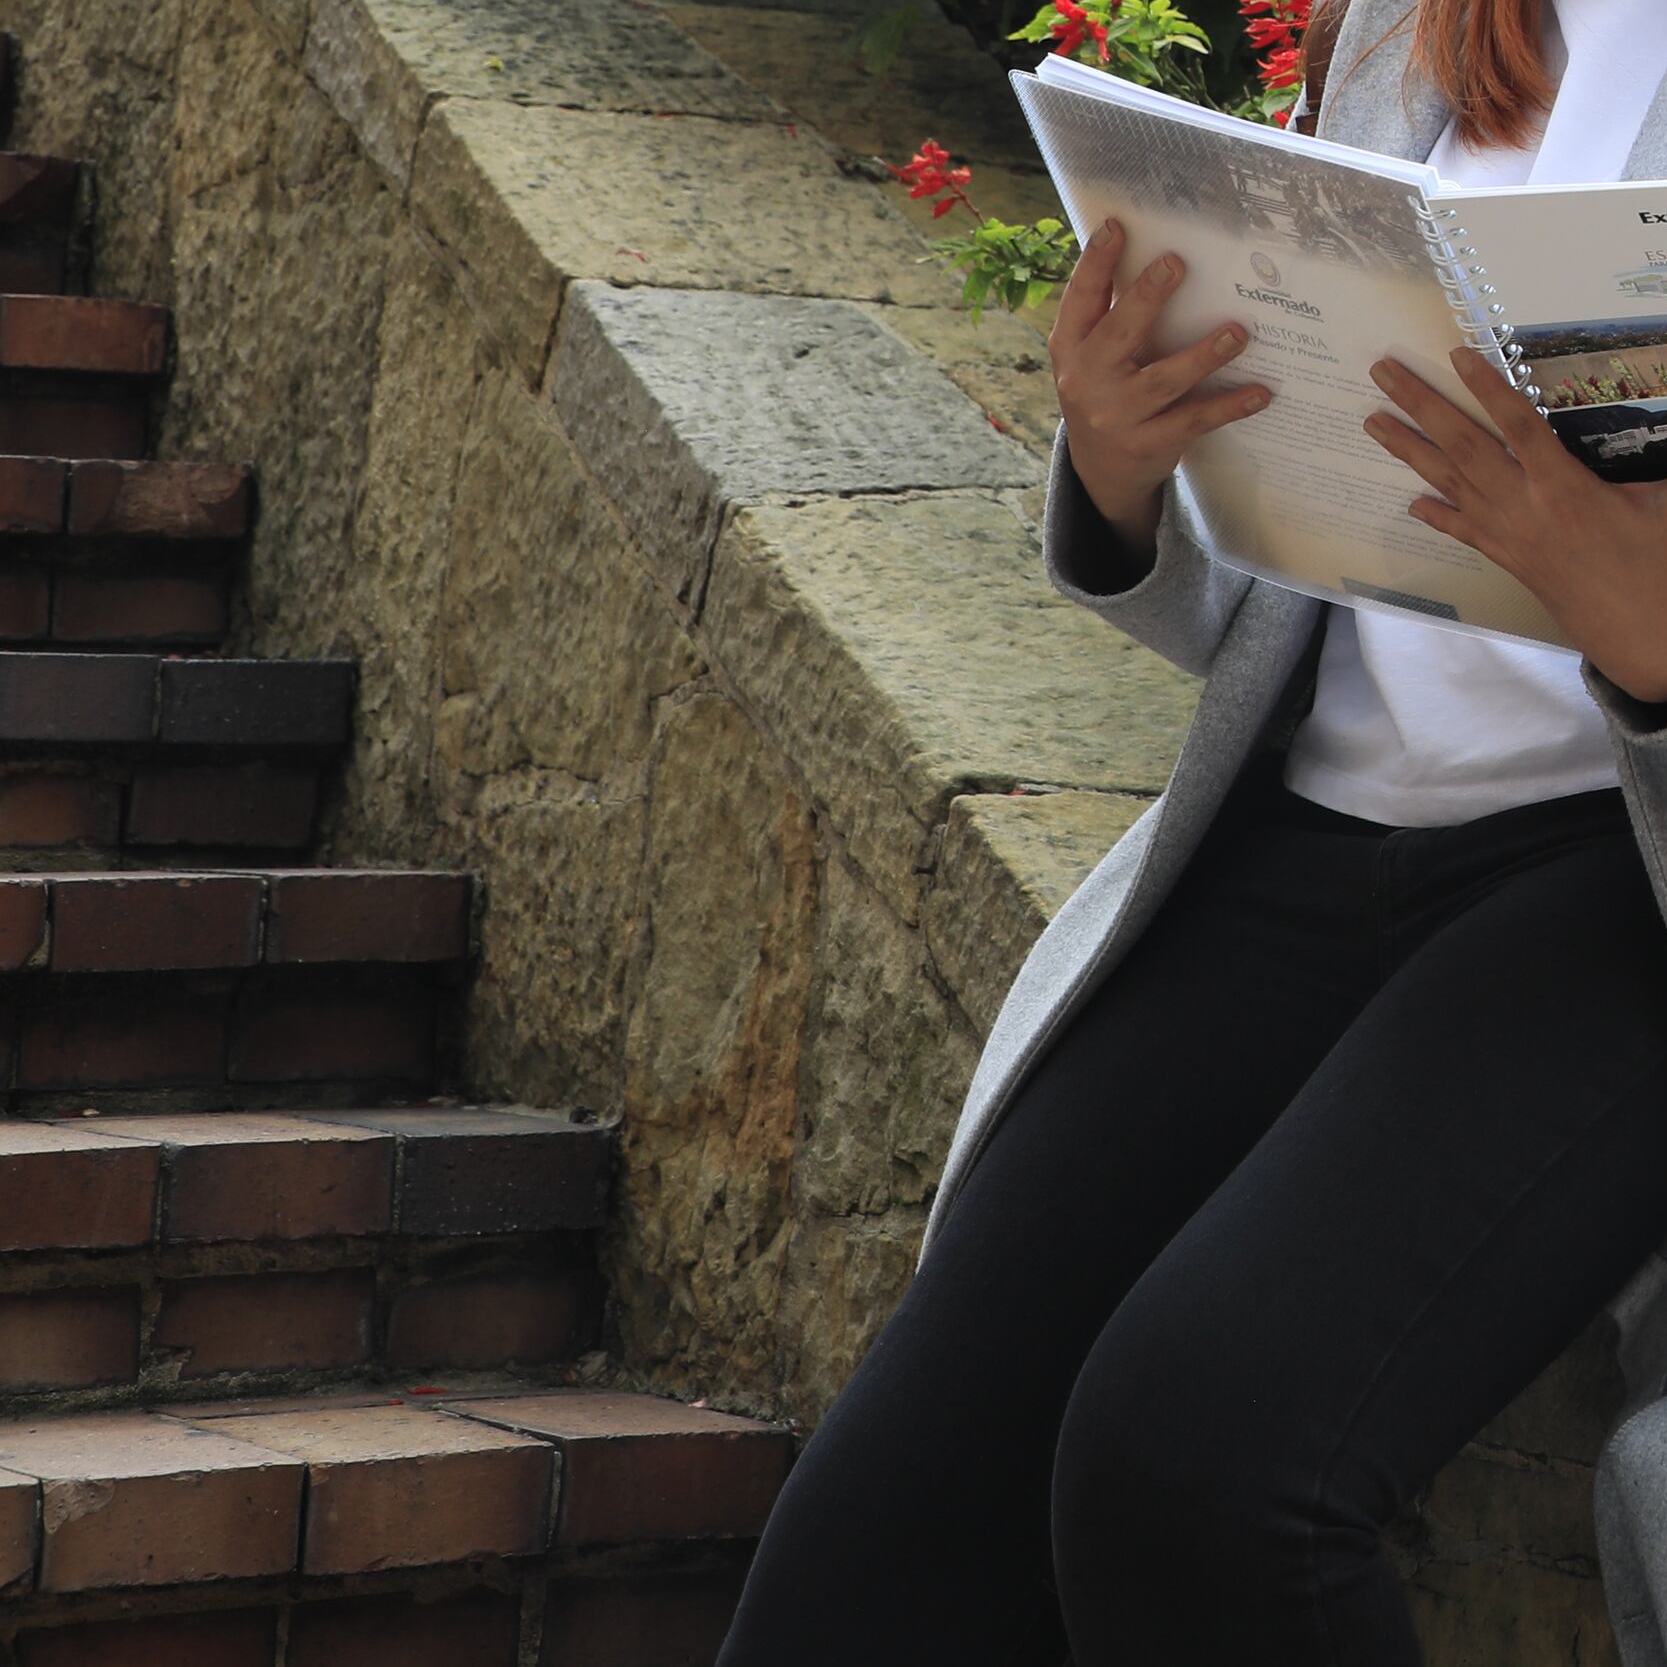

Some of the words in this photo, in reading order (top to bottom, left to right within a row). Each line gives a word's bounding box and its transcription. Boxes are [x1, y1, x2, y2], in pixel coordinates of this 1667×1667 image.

[1234, 283, 1321, 316] Externado
[1253, 321, 1328, 350] HISTORIA
[1253, 335, 1287, 351] Pasado
[1288, 347, 1295, 355] y
[1297, 347, 1340, 363] Presente
